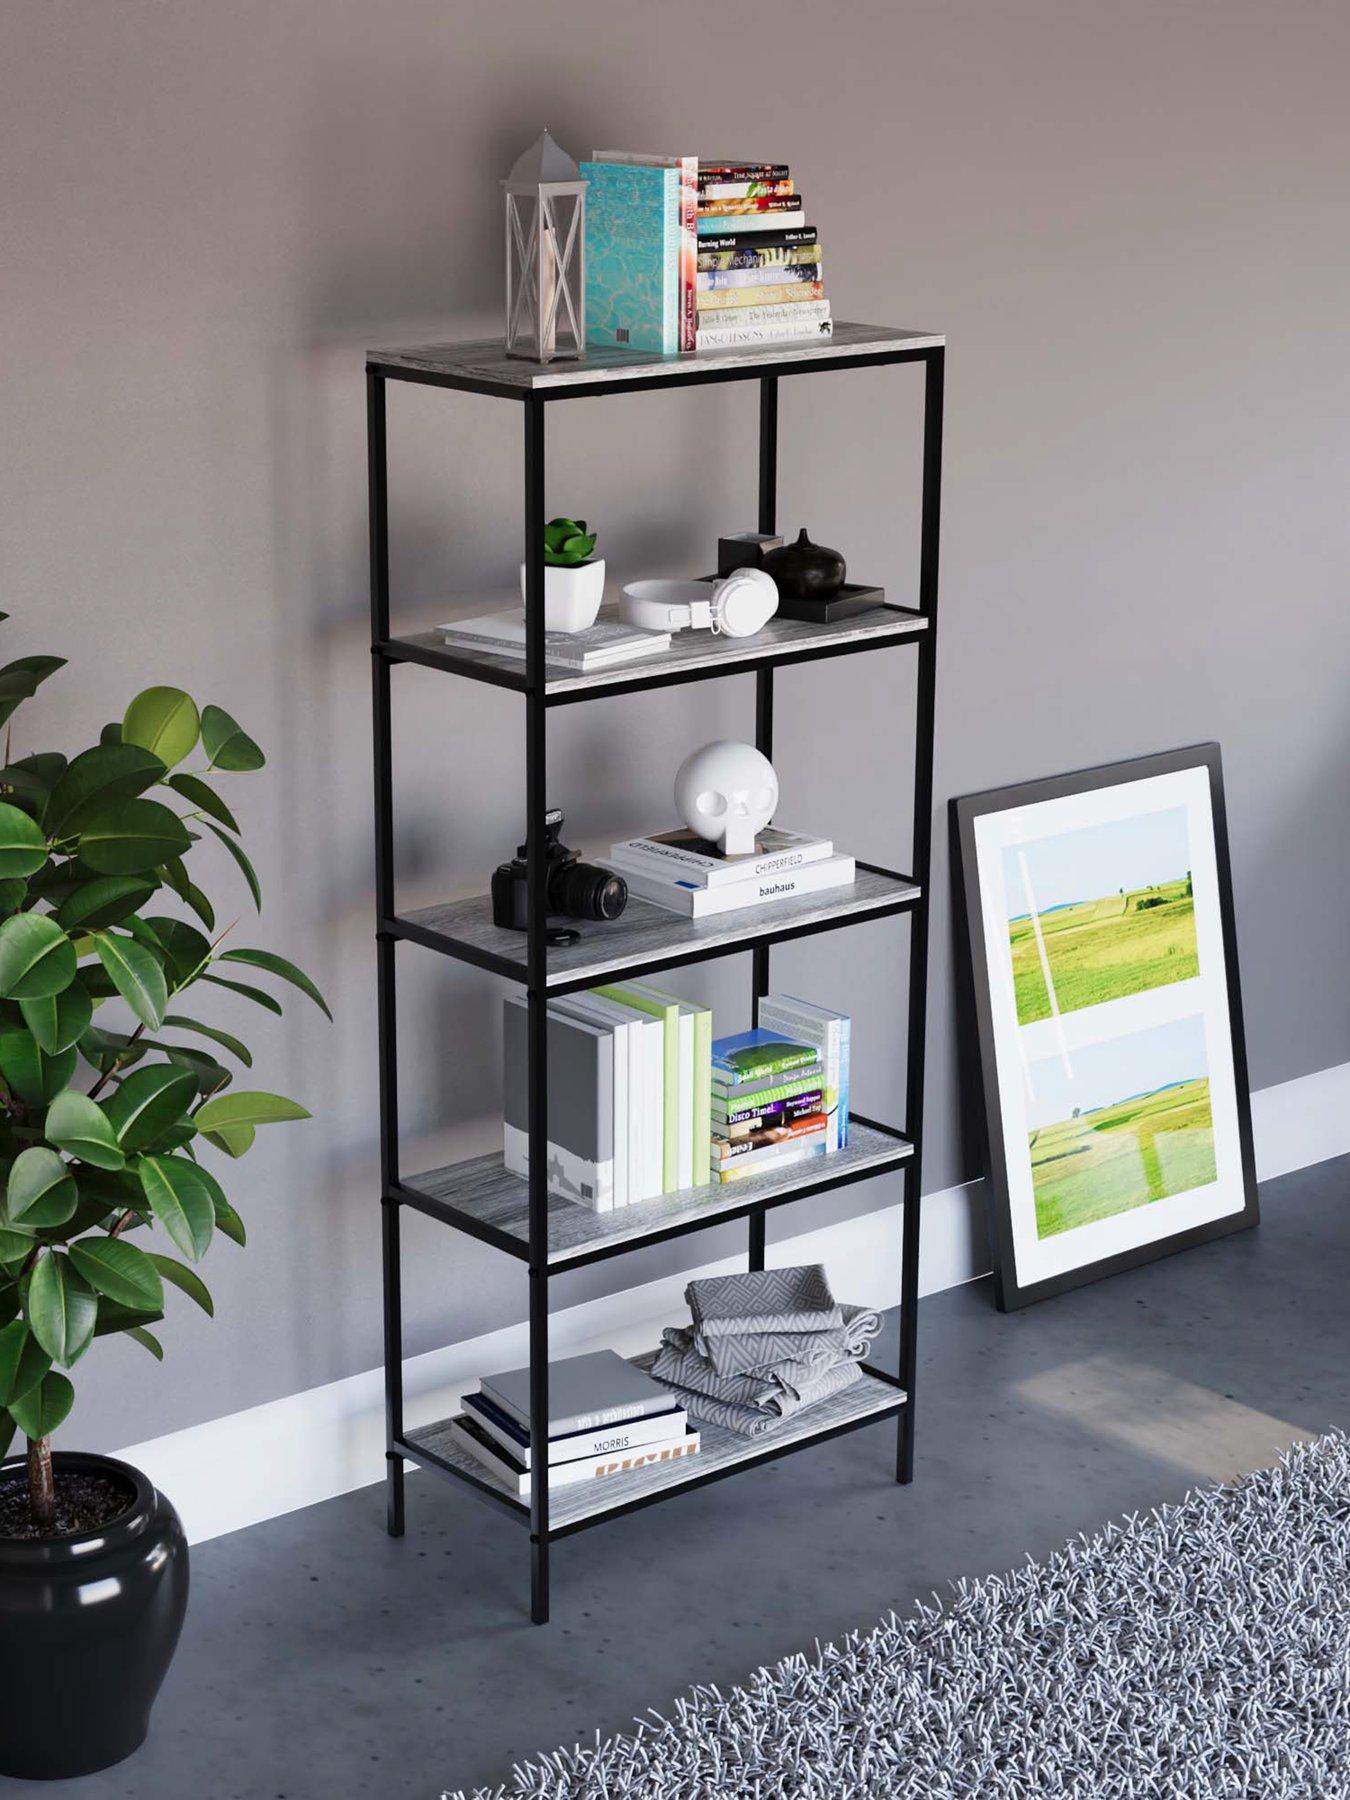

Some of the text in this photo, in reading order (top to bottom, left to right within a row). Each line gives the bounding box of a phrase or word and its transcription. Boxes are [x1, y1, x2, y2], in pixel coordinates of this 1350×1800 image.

[719, 238, 736, 247] World
[629, 842, 714, 867] CHIPPERFIELD
[755, 853, 803, 874] CHIPPERFIELD
[759, 881, 795, 897] bauhaus
[729, 1111, 750, 1123] Disco
[751, 1103, 775, 1118] Time!
[594, 1437, 629, 1452] MORRIS
